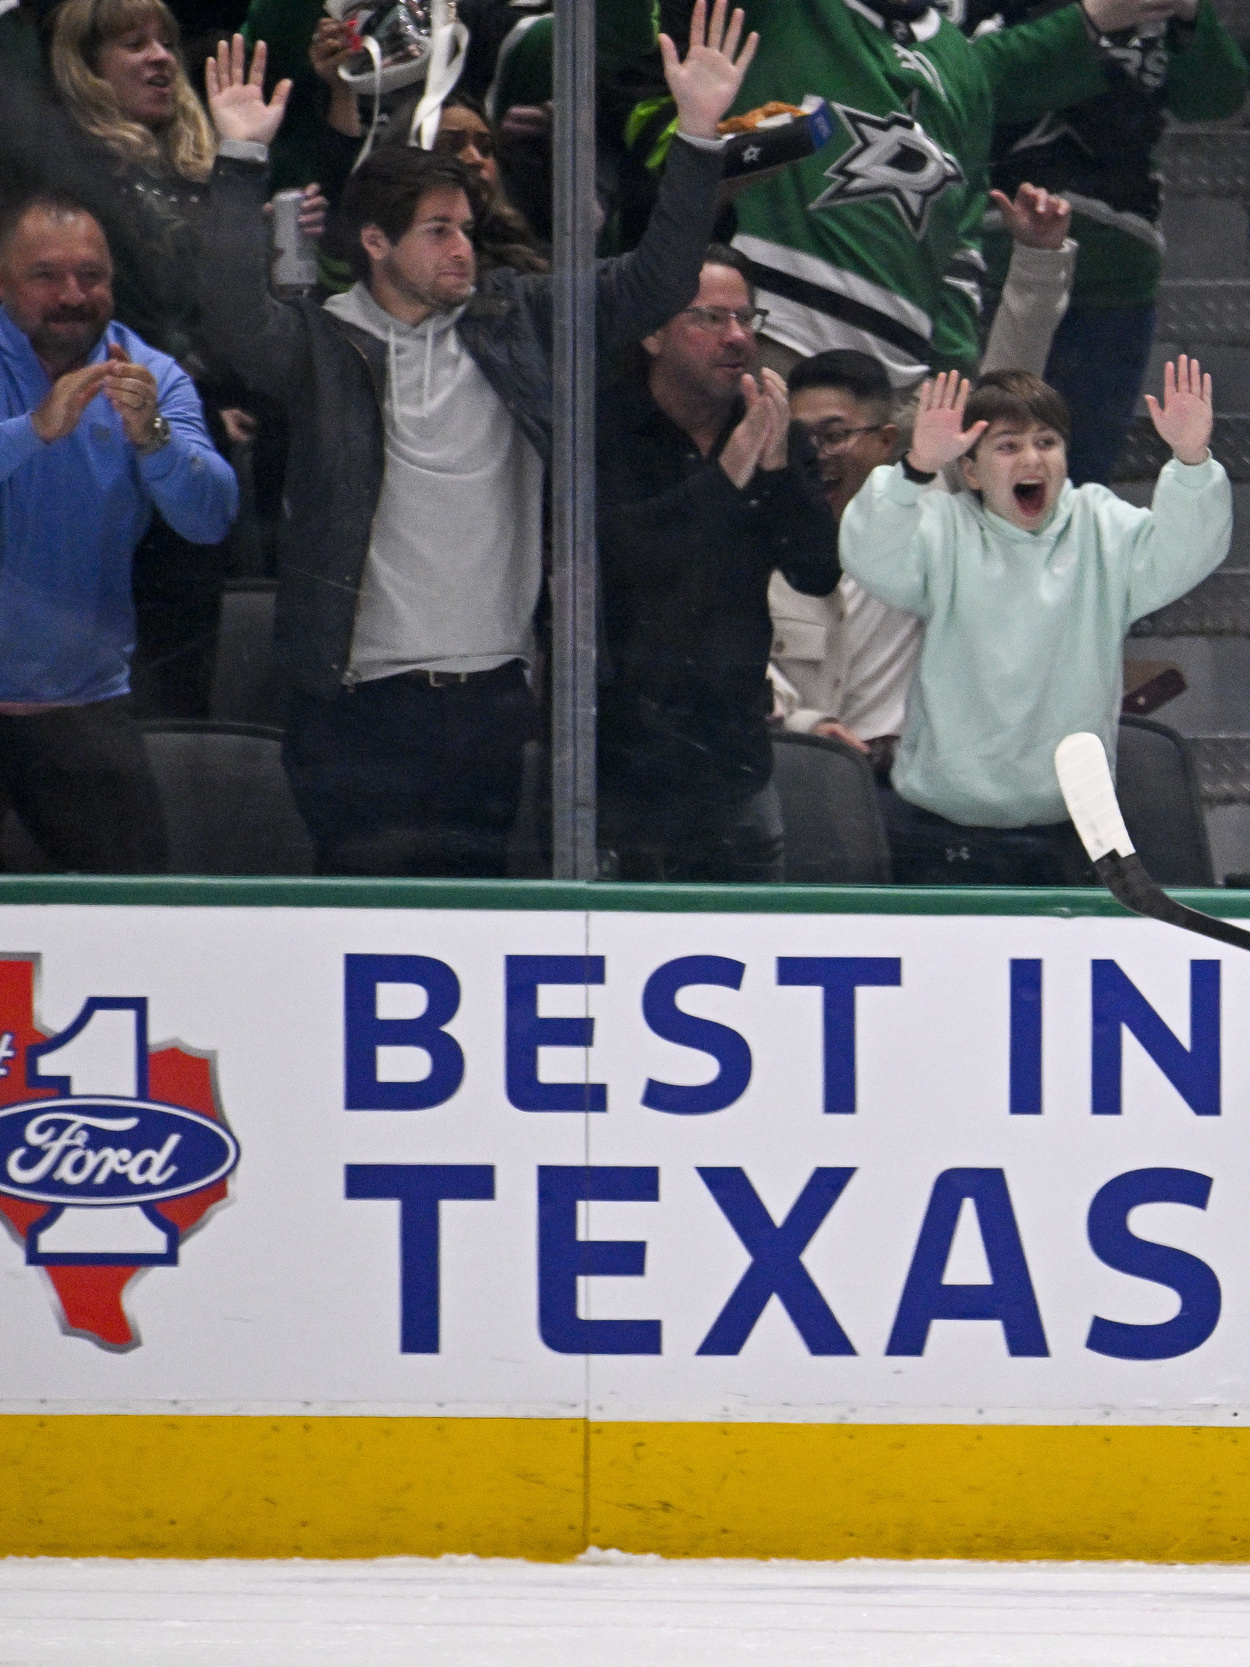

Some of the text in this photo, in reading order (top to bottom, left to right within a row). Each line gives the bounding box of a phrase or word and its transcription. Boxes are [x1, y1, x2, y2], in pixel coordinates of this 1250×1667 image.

[344, 953, 1222, 1117] BEST IN
[6, 1112, 183, 1185] Ford
[344, 1163, 1222, 1361] TEXAS
